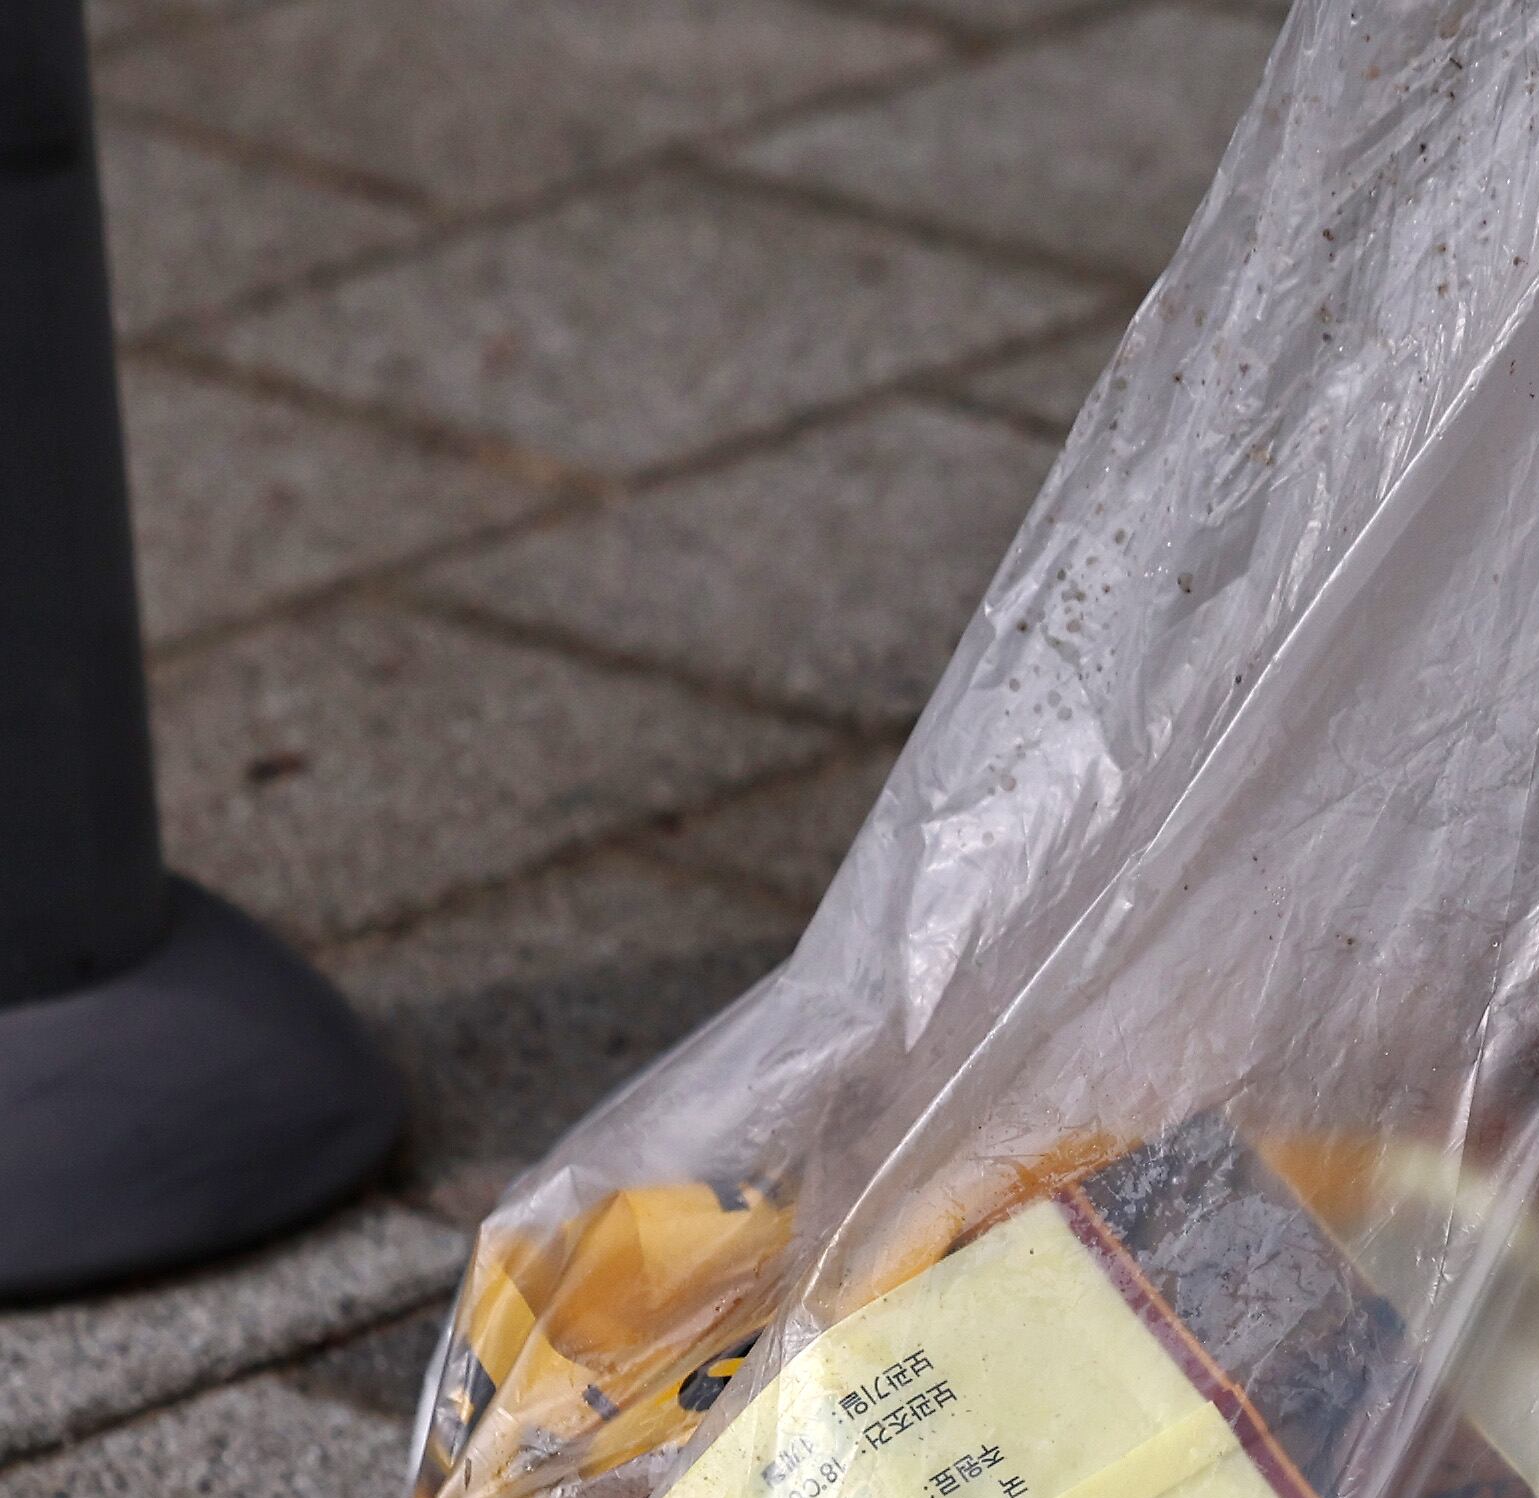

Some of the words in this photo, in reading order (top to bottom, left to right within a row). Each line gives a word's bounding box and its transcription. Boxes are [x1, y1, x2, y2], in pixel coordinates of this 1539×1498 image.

[831, 1349, 934, 1425] 보관기일:
[850, 1379, 957, 1456] 보관조건:
[923, 1444, 1005, 1498] 주원료:
[998, 1476, 1028, 1498] 국
